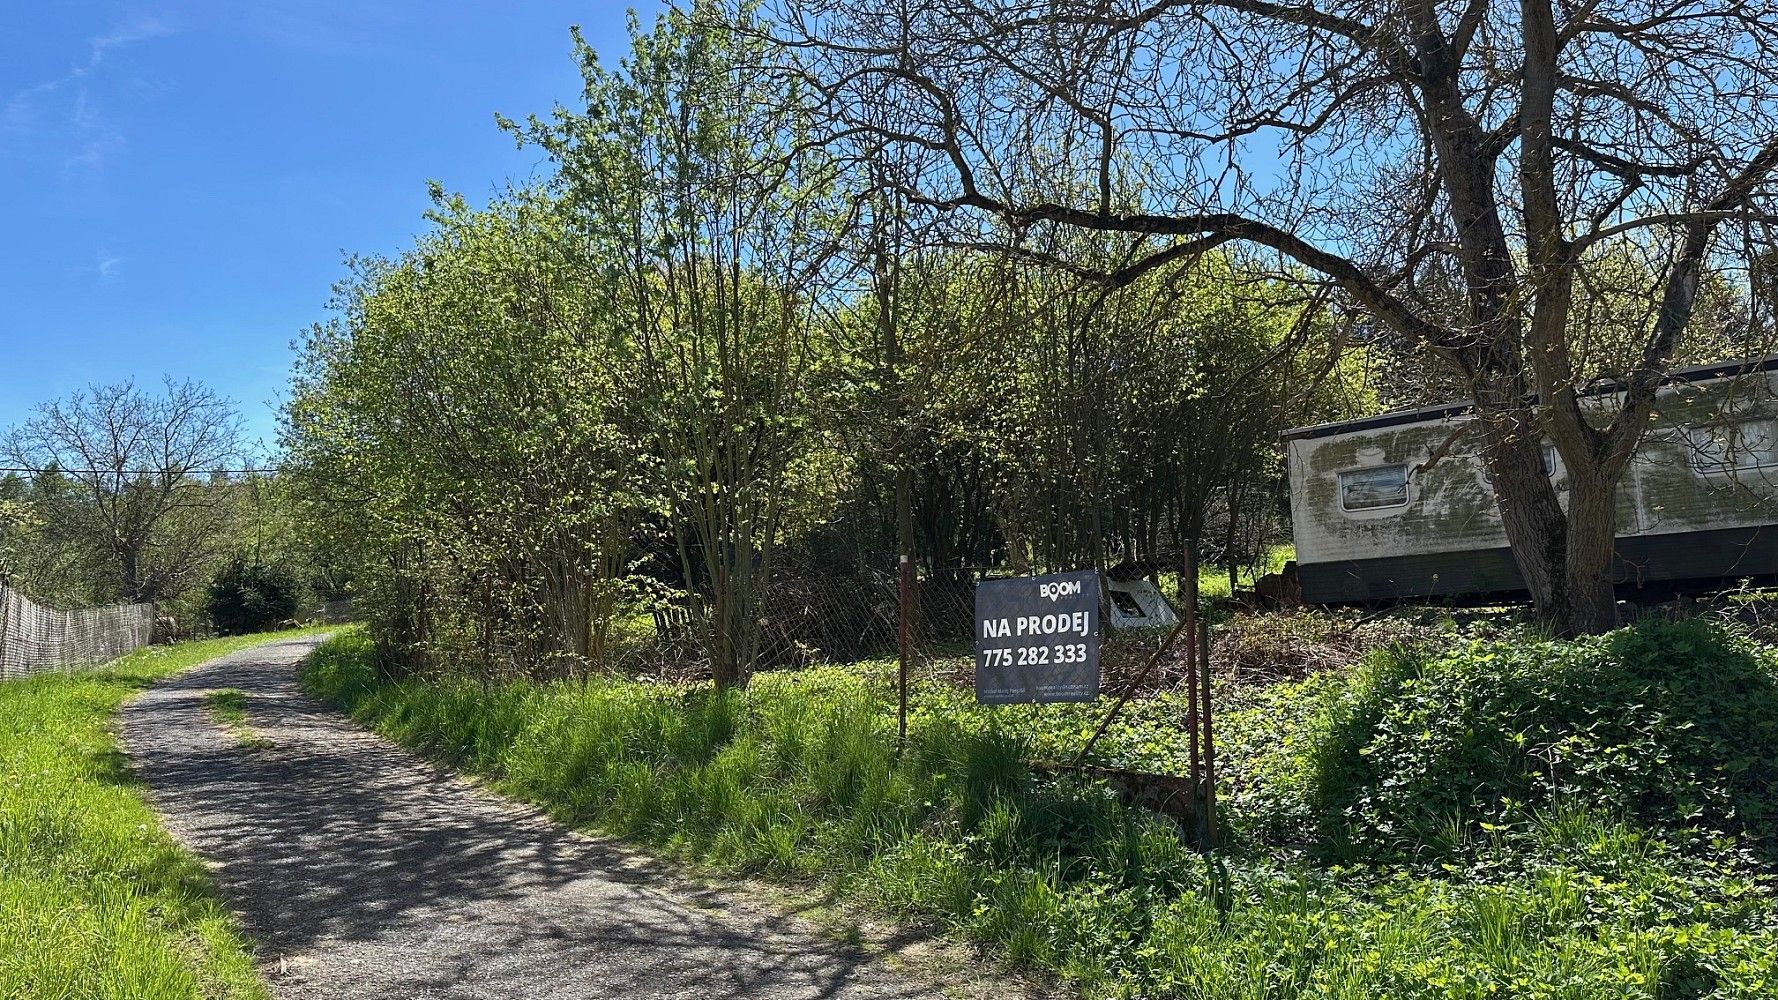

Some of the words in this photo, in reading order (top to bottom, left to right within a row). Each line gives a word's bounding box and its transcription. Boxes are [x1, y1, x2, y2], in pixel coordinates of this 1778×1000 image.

[1039, 580, 1081, 602] BOOM
[983, 618, 1012, 638] NA
[1016, 611, 1089, 637] PRODEJ
[983, 648, 1013, 668] 775
[1017, 646, 1049, 666] 282
[1053, 643, 1087, 664] 333
